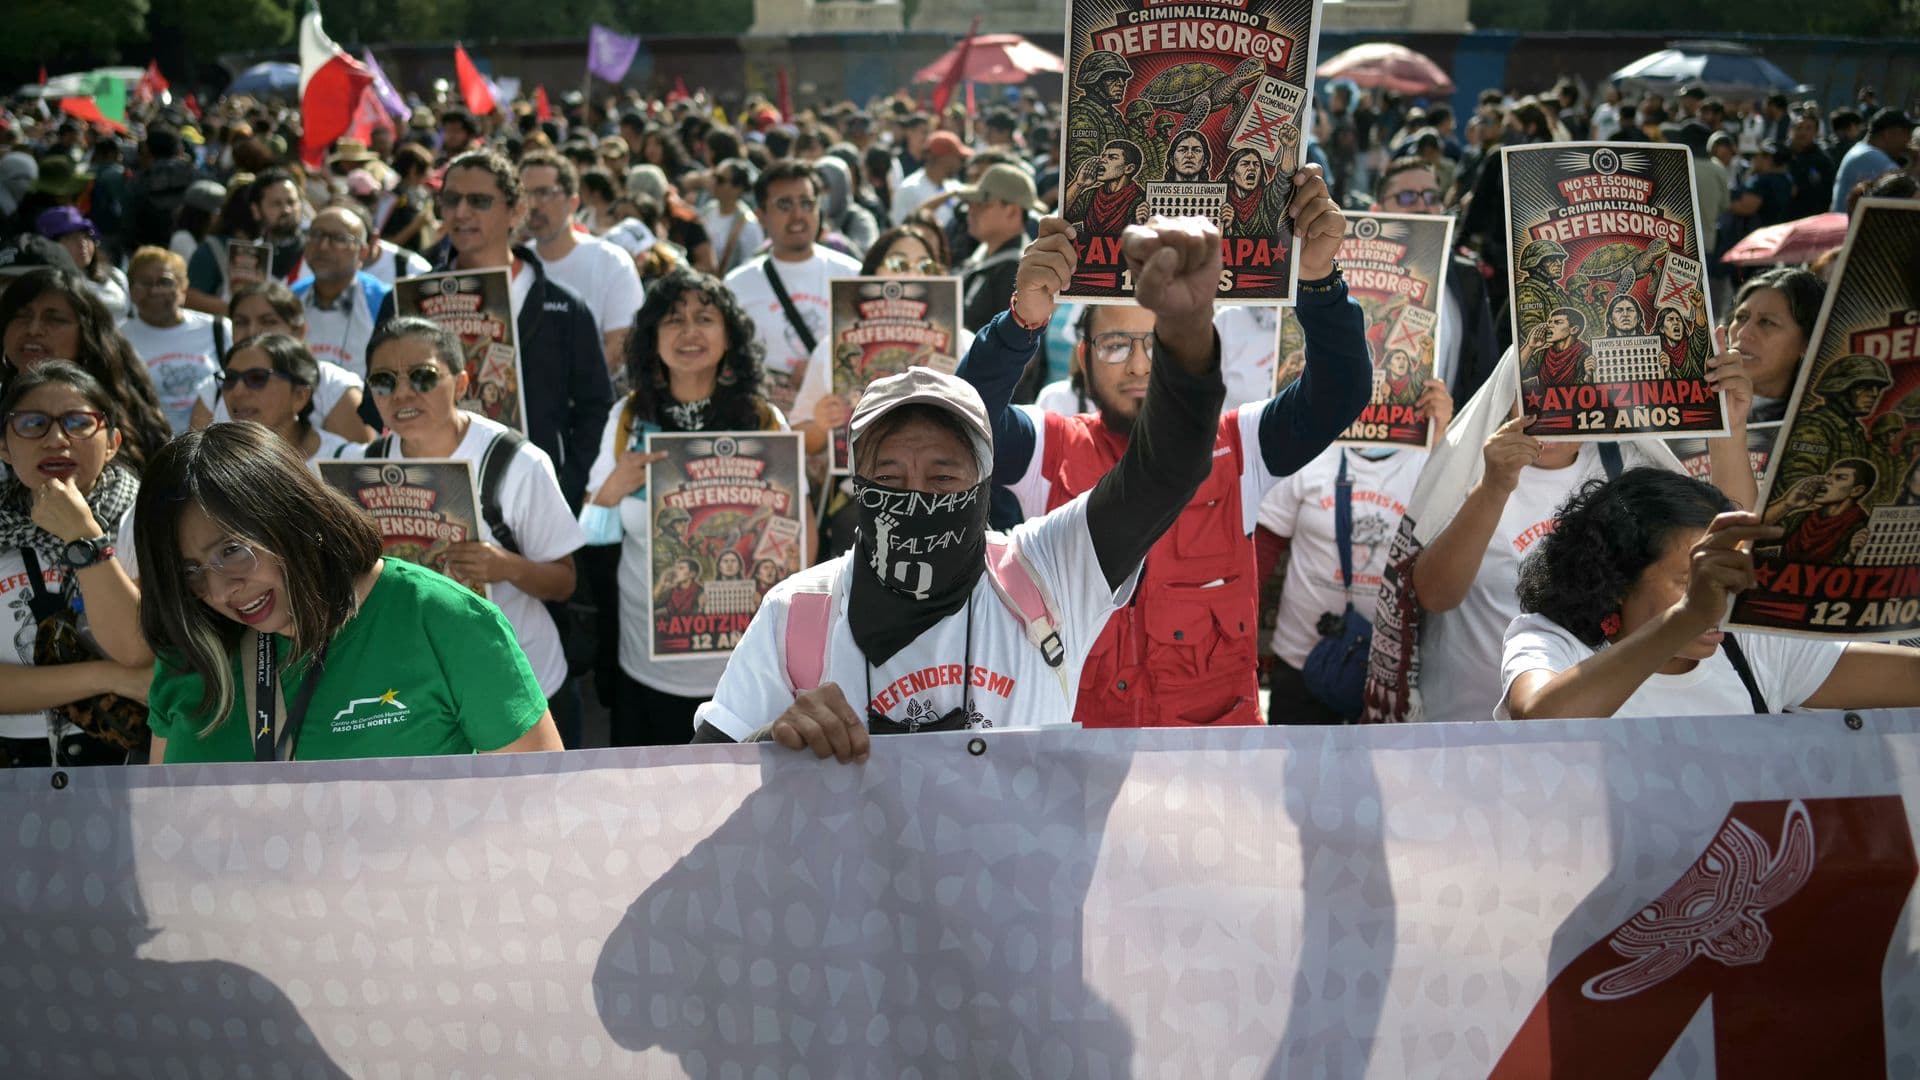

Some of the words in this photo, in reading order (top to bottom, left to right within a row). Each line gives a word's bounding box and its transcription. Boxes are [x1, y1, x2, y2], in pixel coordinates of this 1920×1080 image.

[1129, 5, 1259, 27] CRIMINALIZANDO
[1102, 21, 1286, 64] DEFENSOR@S
[1265, 82, 1299, 103] CNDH
[1173, 186, 1182, 195] SE
[1182, 186, 1193, 195] LOS
[1564, 178, 1581, 193] NO
[1584, 176, 1598, 187] SE
[1601, 175, 1649, 192] ESCONDE
[1573, 187, 1592, 201] LA
[1595, 187, 1644, 201] VERDAD
[1558, 201, 1658, 217] CRIMINALIZANDO
[1538, 212, 1680, 243] DEFENSOR@S
[1350, 249, 1397, 264] VERDAD
[1671, 256, 1697, 273] CNDH
[1344, 268, 1423, 299] ENSOR@S
[1542, 380, 1705, 411] AYOTZINAPA
[1577, 411, 1606, 429] 12
[1614, 405, 1681, 429] AÑOS
[363, 489, 376, 499] NO
[390, 486, 433, 500] ESCONDE
[370, 498, 384, 508] LA
[384, 497, 428, 510] VERDAD
[381, 517, 463, 543] ENSOR@S
[1810, 601, 1851, 626] 12
[692, 634, 713, 649] 12
[332, 725, 352, 733] PASO
[353, 723, 366, 731] DEL
[367, 718, 392, 728] NORTE
[393, 715, 408, 723] A.C.
